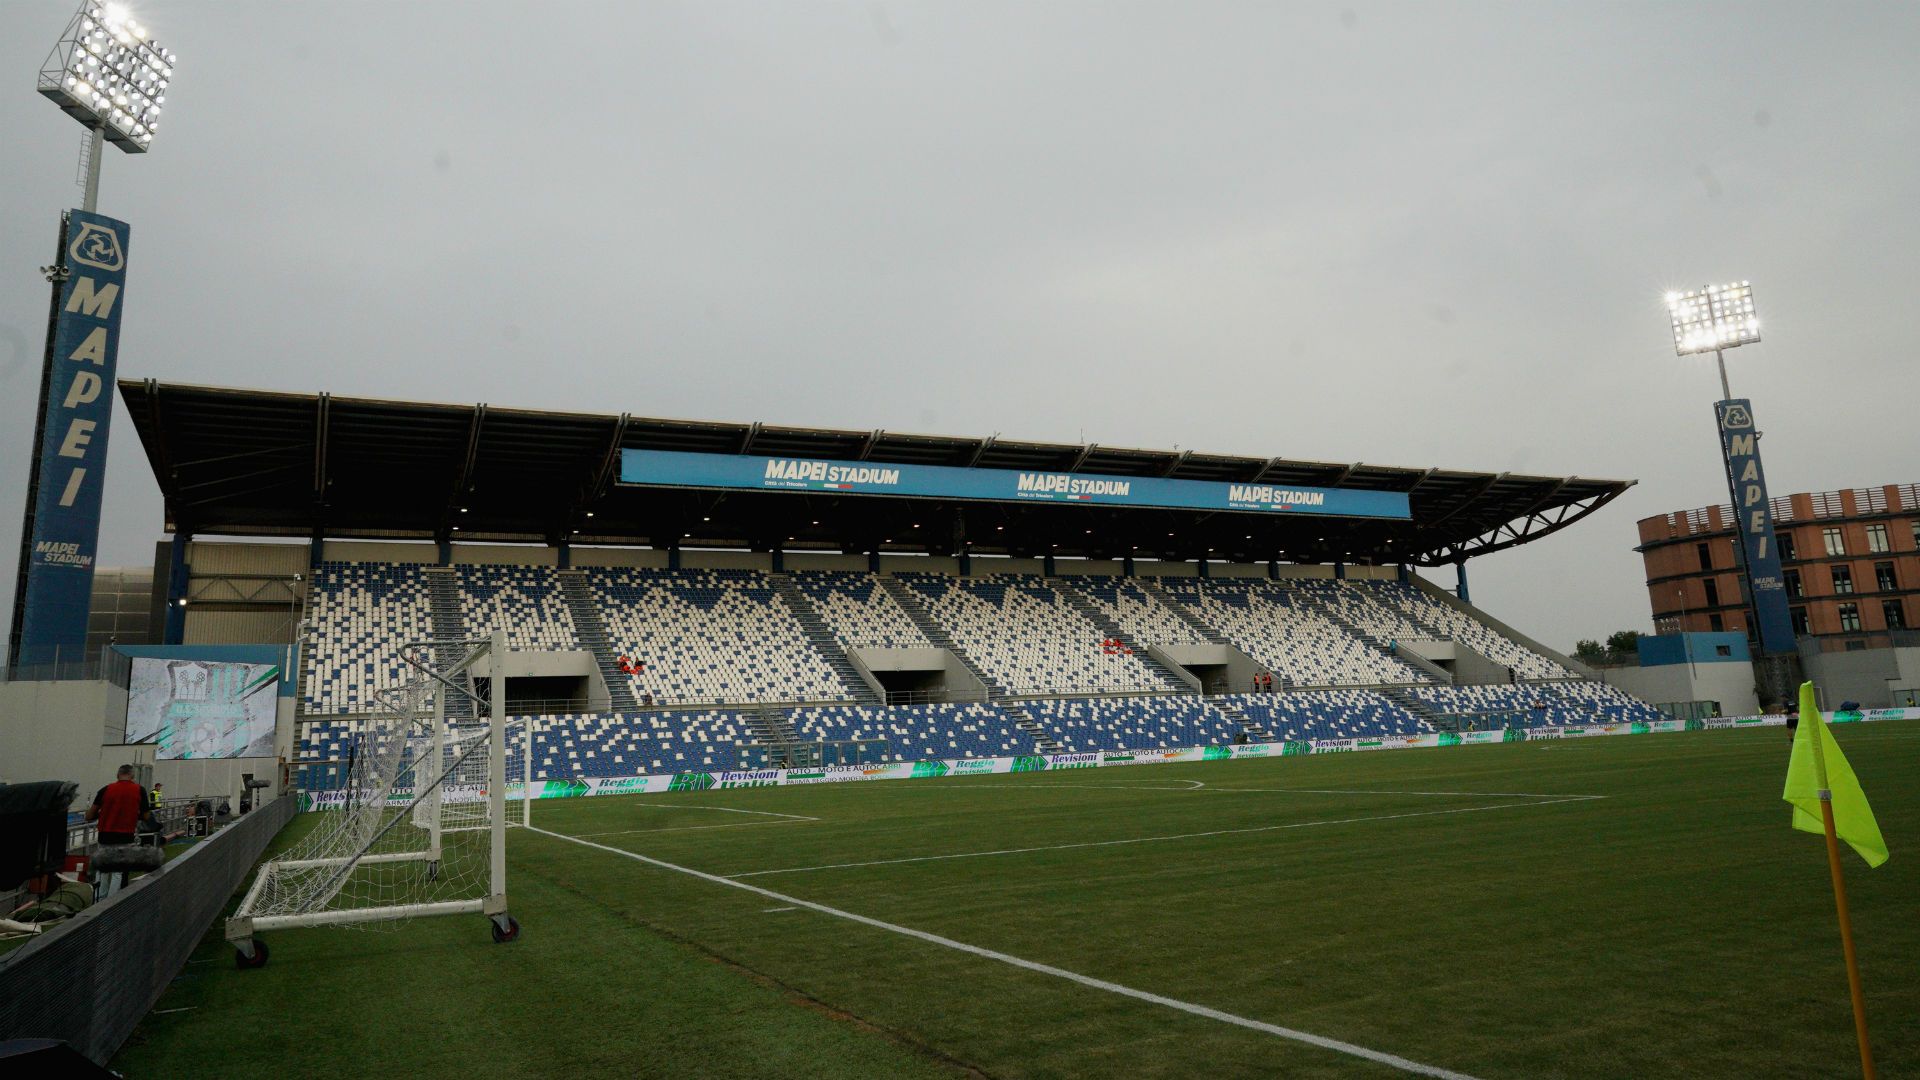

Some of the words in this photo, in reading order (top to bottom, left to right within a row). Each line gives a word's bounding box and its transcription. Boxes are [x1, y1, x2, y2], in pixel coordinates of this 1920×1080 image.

[59, 276, 120, 507] MAPEI
[764, 459, 829, 481] MAPEI
[828, 466, 900, 485] STADIUM
[1017, 473, 1070, 492] MAPEI
[1070, 479, 1130, 496] STADIUM
[1229, 485, 1273, 503] MAPEI
[1273, 490, 1324, 505] STADIUM
[1731, 434, 1767, 559] MAPEI
[36, 541, 80, 554] MAPEI
[44, 552, 92, 565] STADIUM
[1315, 740, 1352, 748] Revisioni
[955, 760, 995, 768] Reggio
[1051, 753, 1097, 763] Revisioni
[720, 769, 779, 781] Revisioni
[818, 766, 845, 774] MOTO
[599, 777, 649, 788] Reggio
[720, 780, 778, 789] Italia
[596, 787, 645, 796] Revisioni
